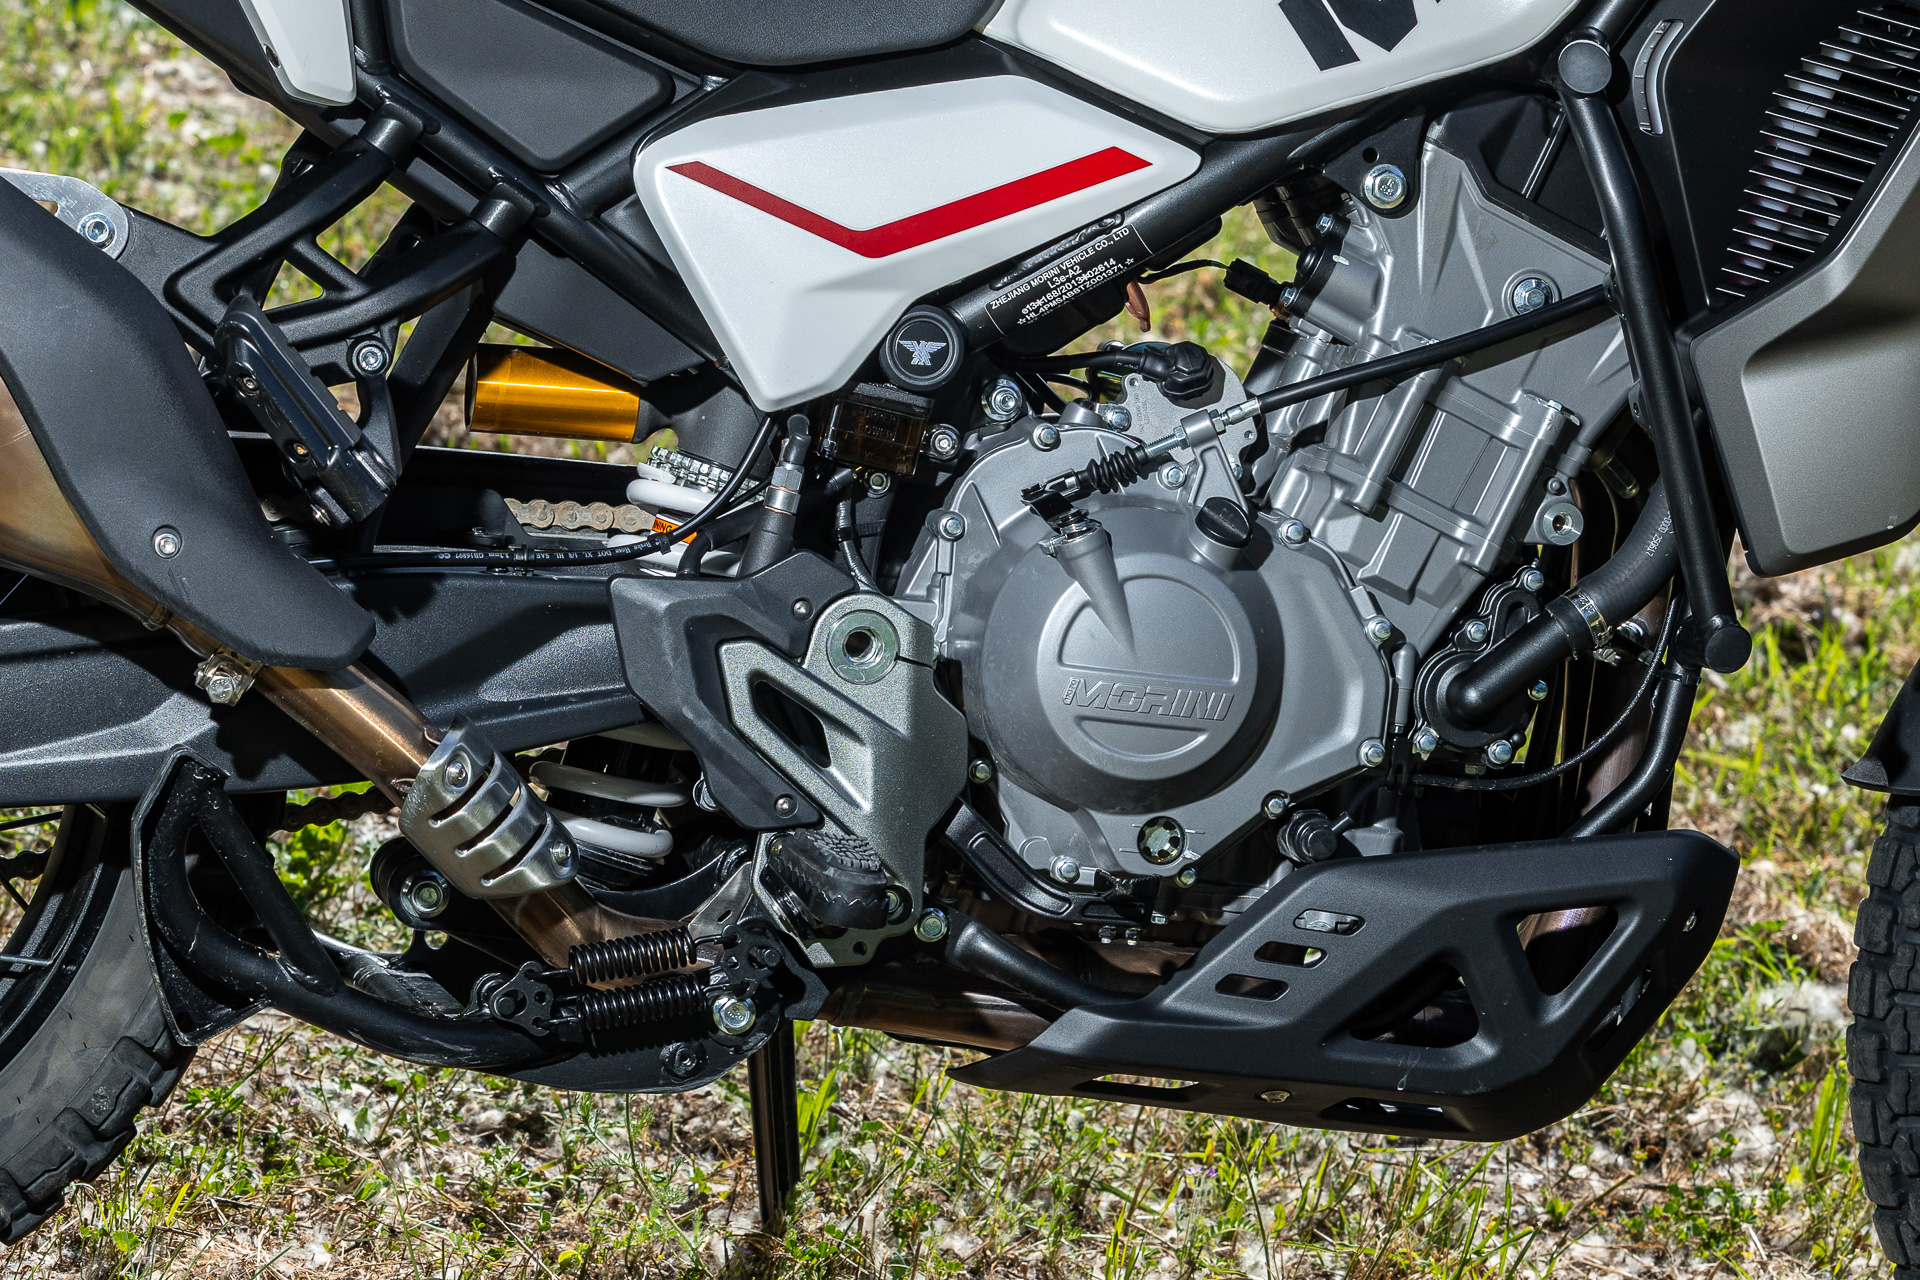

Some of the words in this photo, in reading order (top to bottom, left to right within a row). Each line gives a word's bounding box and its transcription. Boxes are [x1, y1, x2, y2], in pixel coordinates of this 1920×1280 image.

[989, 283, 1031, 310] ZHEJIANG
[1030, 266, 1061, 288] MORINI
[1060, 247, 1096, 270] VEHICLE
[1095, 240, 1114, 251] CO.,
[1112, 227, 1130, 241] LTD
[1047, 265, 1083, 289] L3e-A2
[633, 541, 652, 550] Brake
[1645, 533, 1663, 557] 250617
[1063, 677, 1078, 704] MOTO
[1075, 679, 1235, 722] MORINI
